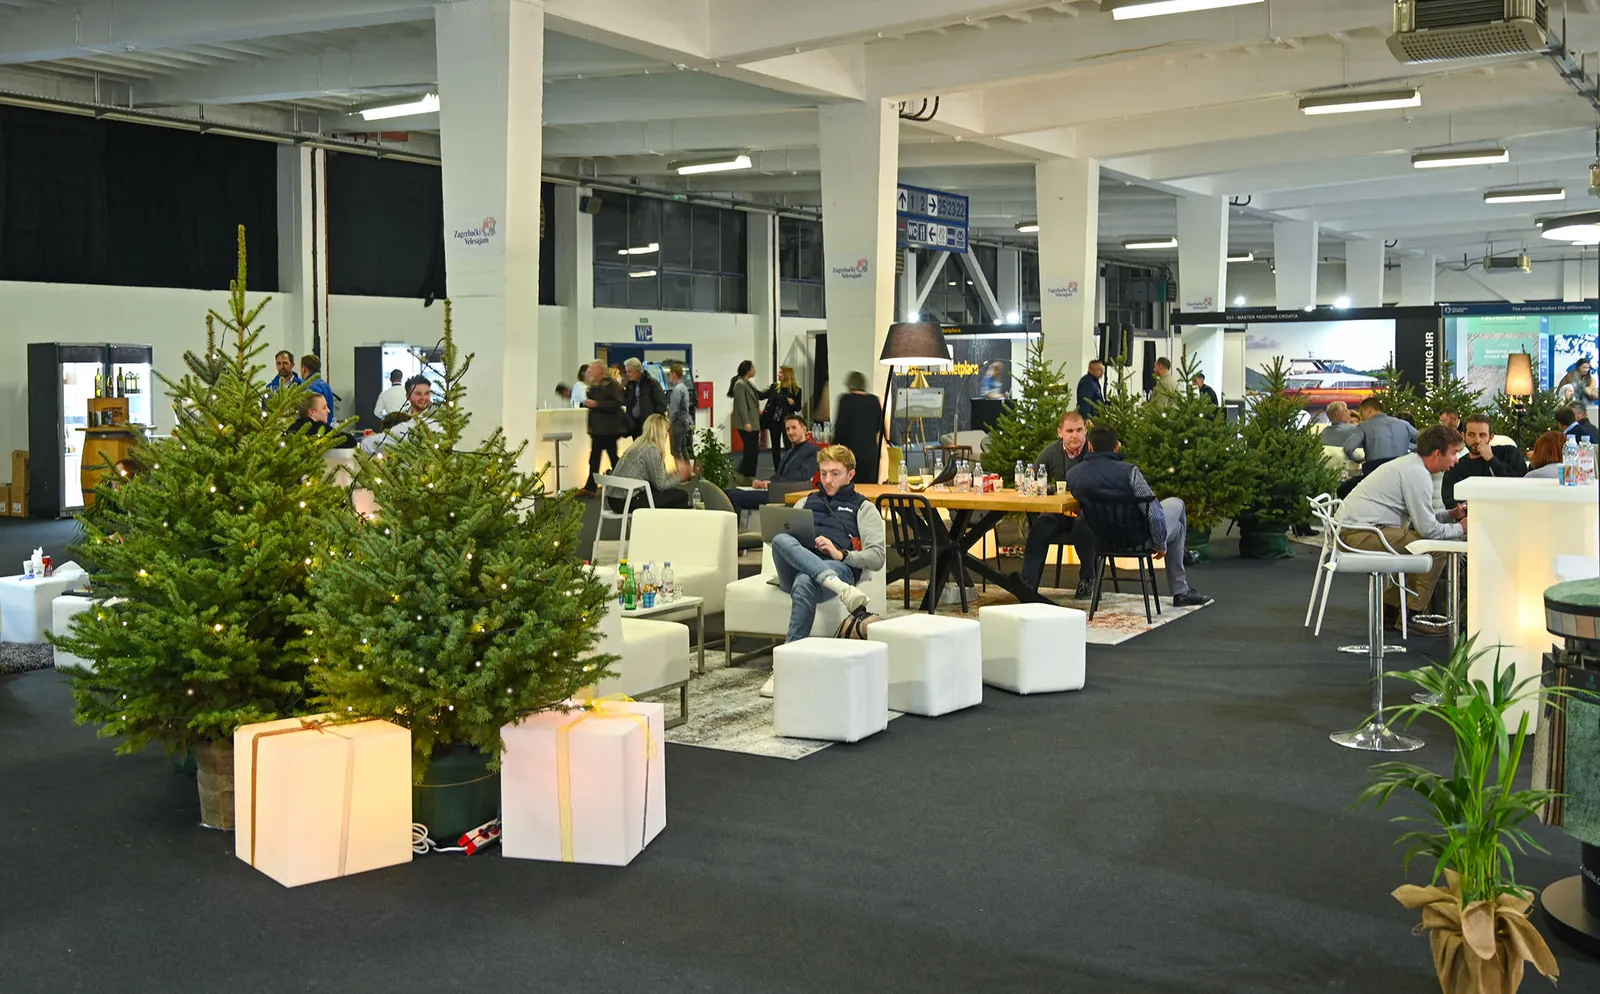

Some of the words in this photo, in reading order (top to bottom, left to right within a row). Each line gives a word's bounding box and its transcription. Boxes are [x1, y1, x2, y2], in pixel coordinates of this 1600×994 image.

[920, 196, 925, 211] 2
[938, 199, 947, 216] 25
[947, 201, 956, 217] 23
[956, 203, 965, 218] 22
[908, 225, 917, 237] WC
[636, 326, 651, 340] WC
